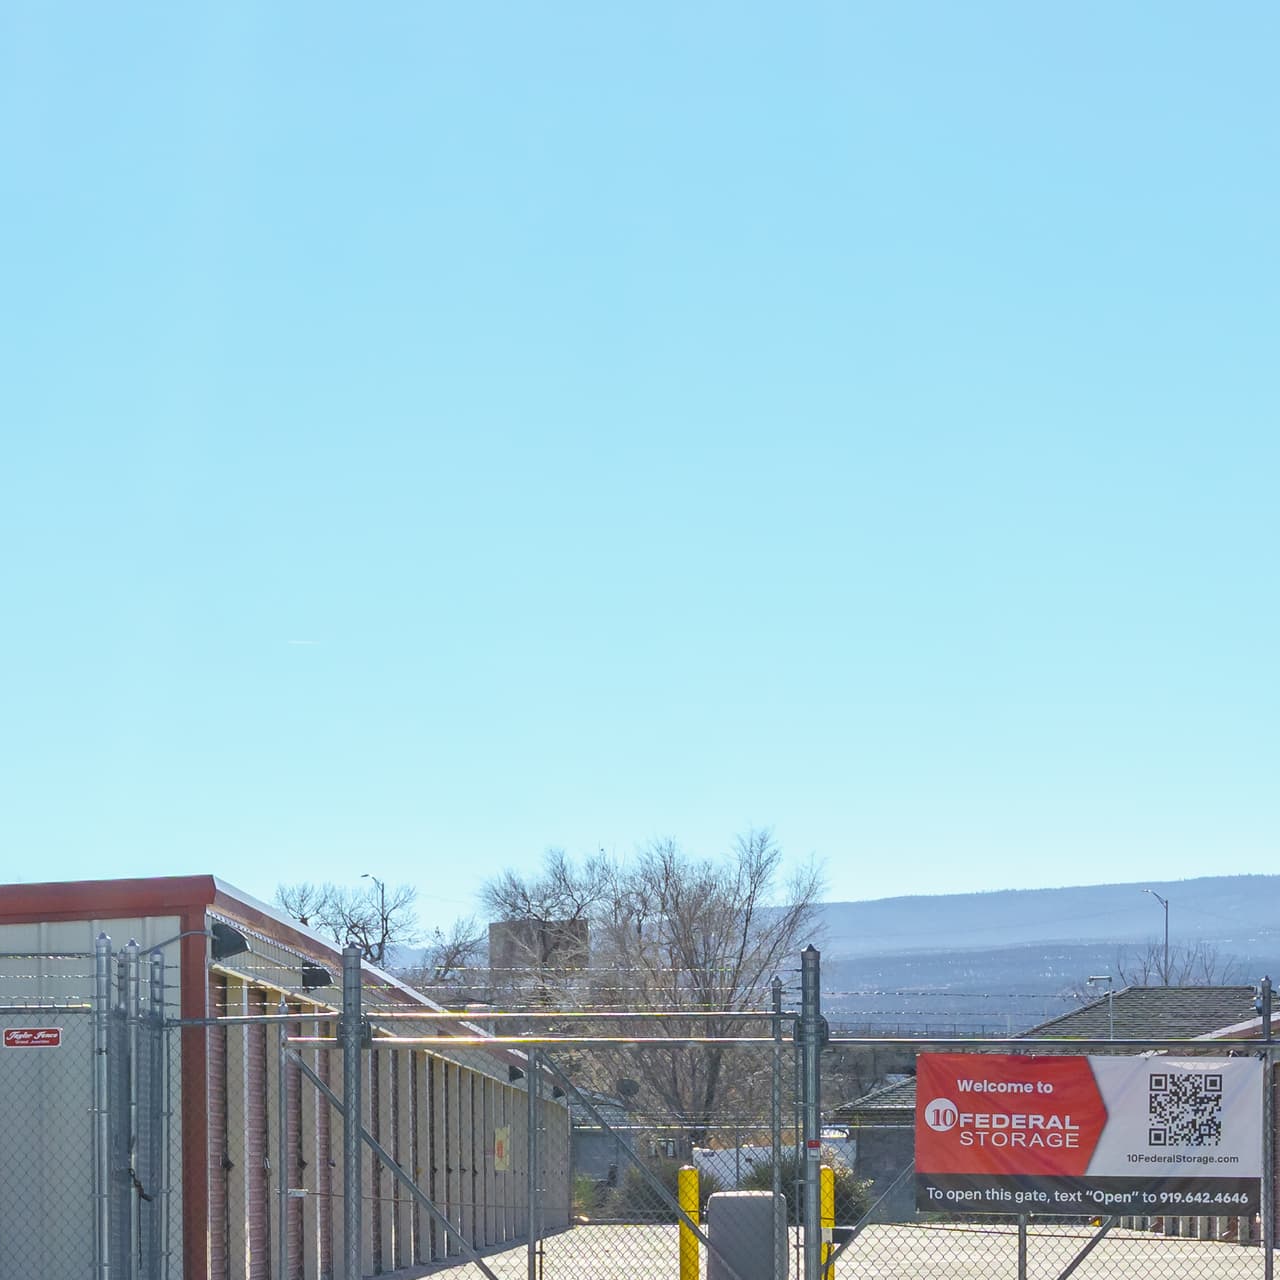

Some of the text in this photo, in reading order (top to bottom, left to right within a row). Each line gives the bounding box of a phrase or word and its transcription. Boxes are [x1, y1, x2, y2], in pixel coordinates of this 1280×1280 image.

[957, 1079, 1053, 1094] Welcome to
[931, 1108, 1080, 1130] 10 FEDERAL
[959, 1131, 1080, 1148] STORAGE
[1127, 1153, 1239, 1165] 10FederalStorage.com
[926, 1187, 944, 1200] To
[946, 1189, 982, 1203] open
[985, 1187, 1012, 1201] this
[1014, 1189, 1051, 1204] gate,
[1054, 1190, 1083, 1202] text
[1142, 1191, 1157, 1203] to
[1159, 1191, 1249, 1204] 919.642.4646
